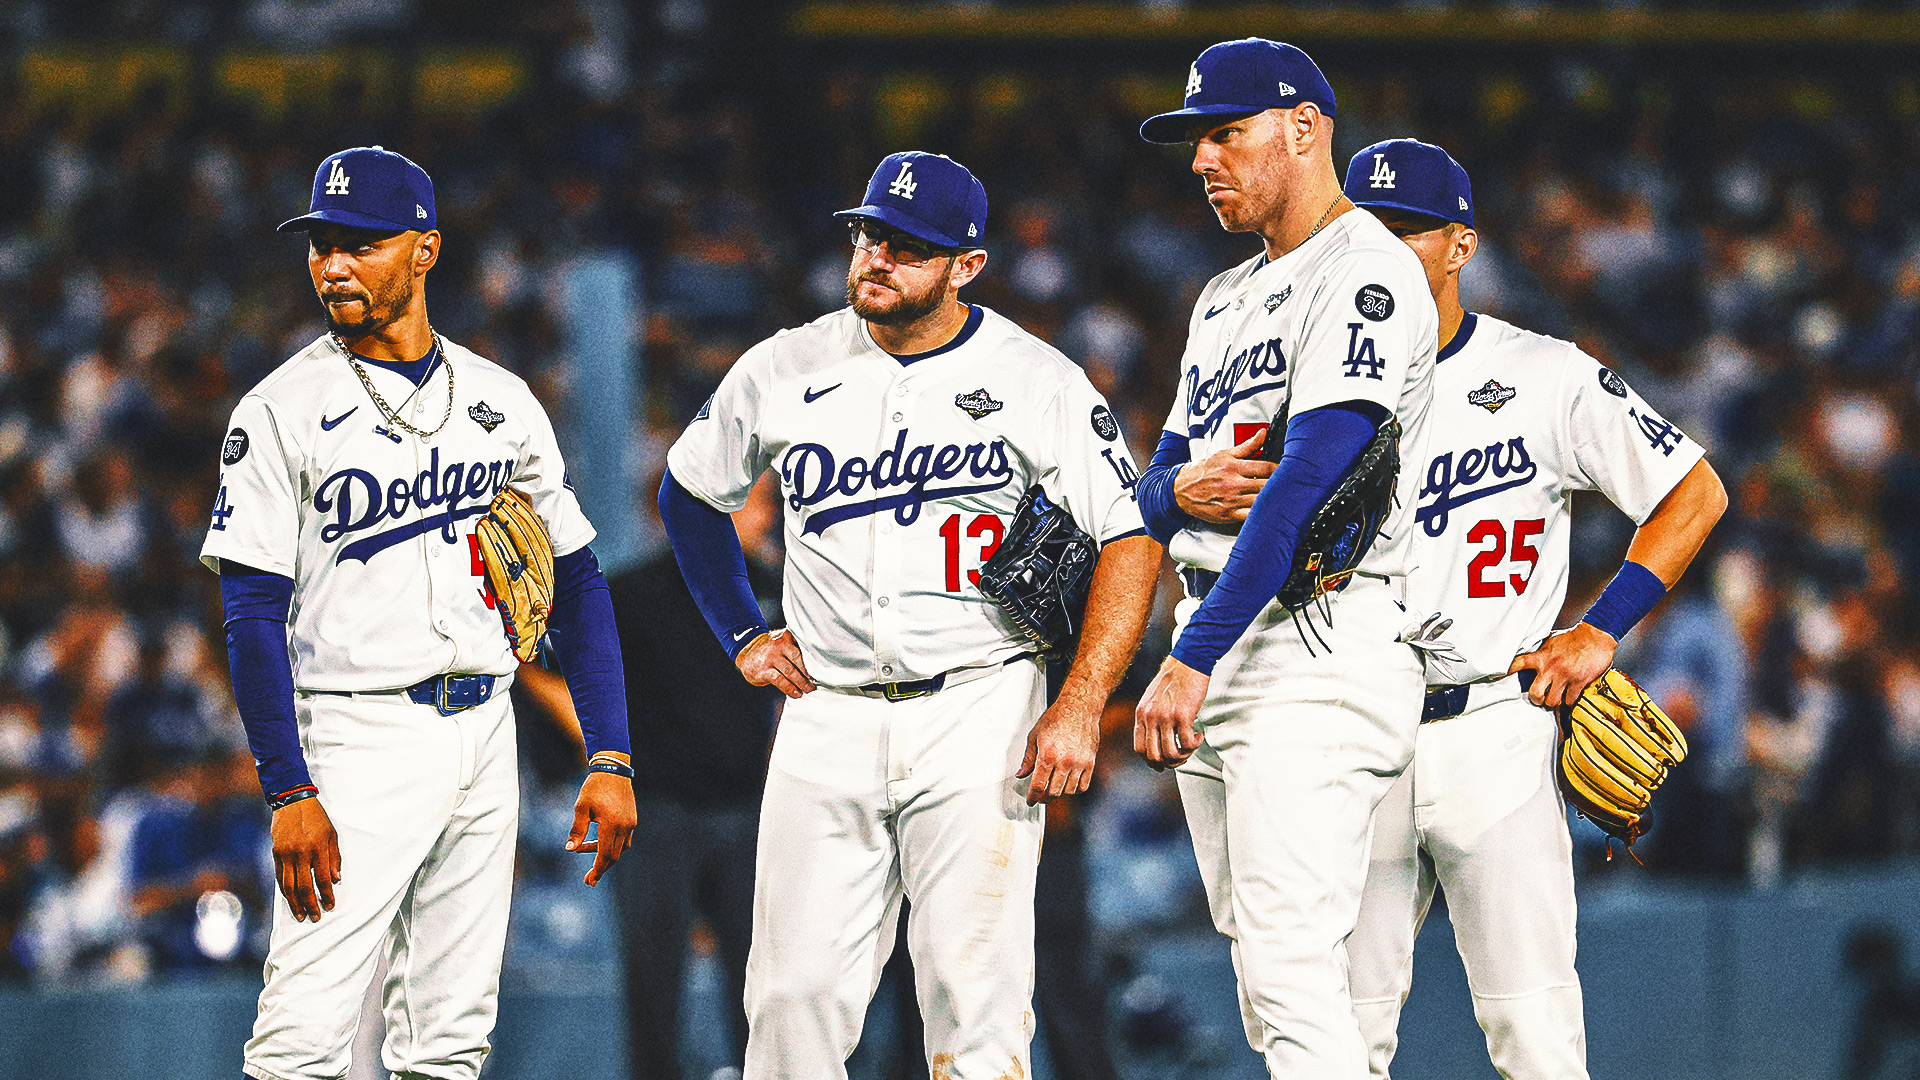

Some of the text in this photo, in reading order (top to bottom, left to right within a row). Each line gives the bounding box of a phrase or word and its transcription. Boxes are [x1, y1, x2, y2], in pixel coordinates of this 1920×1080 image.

[325, 159, 350, 195] LA
[889, 161, 918, 200] LA
[1369, 153, 1396, 189] LA
[1362, 296, 1386, 317] 34
[1342, 322, 1386, 381] LA
[1186, 337, 1287, 441] odgrs
[1628, 406, 1684, 457] LA
[213, 473, 235, 532] A
[782, 428, 1013, 527] Dodgers
[1101, 448, 1140, 502] LA
[1418, 435, 1537, 538] gers
[939, 514, 1005, 592] 13
[1467, 518, 1545, 598] 25
